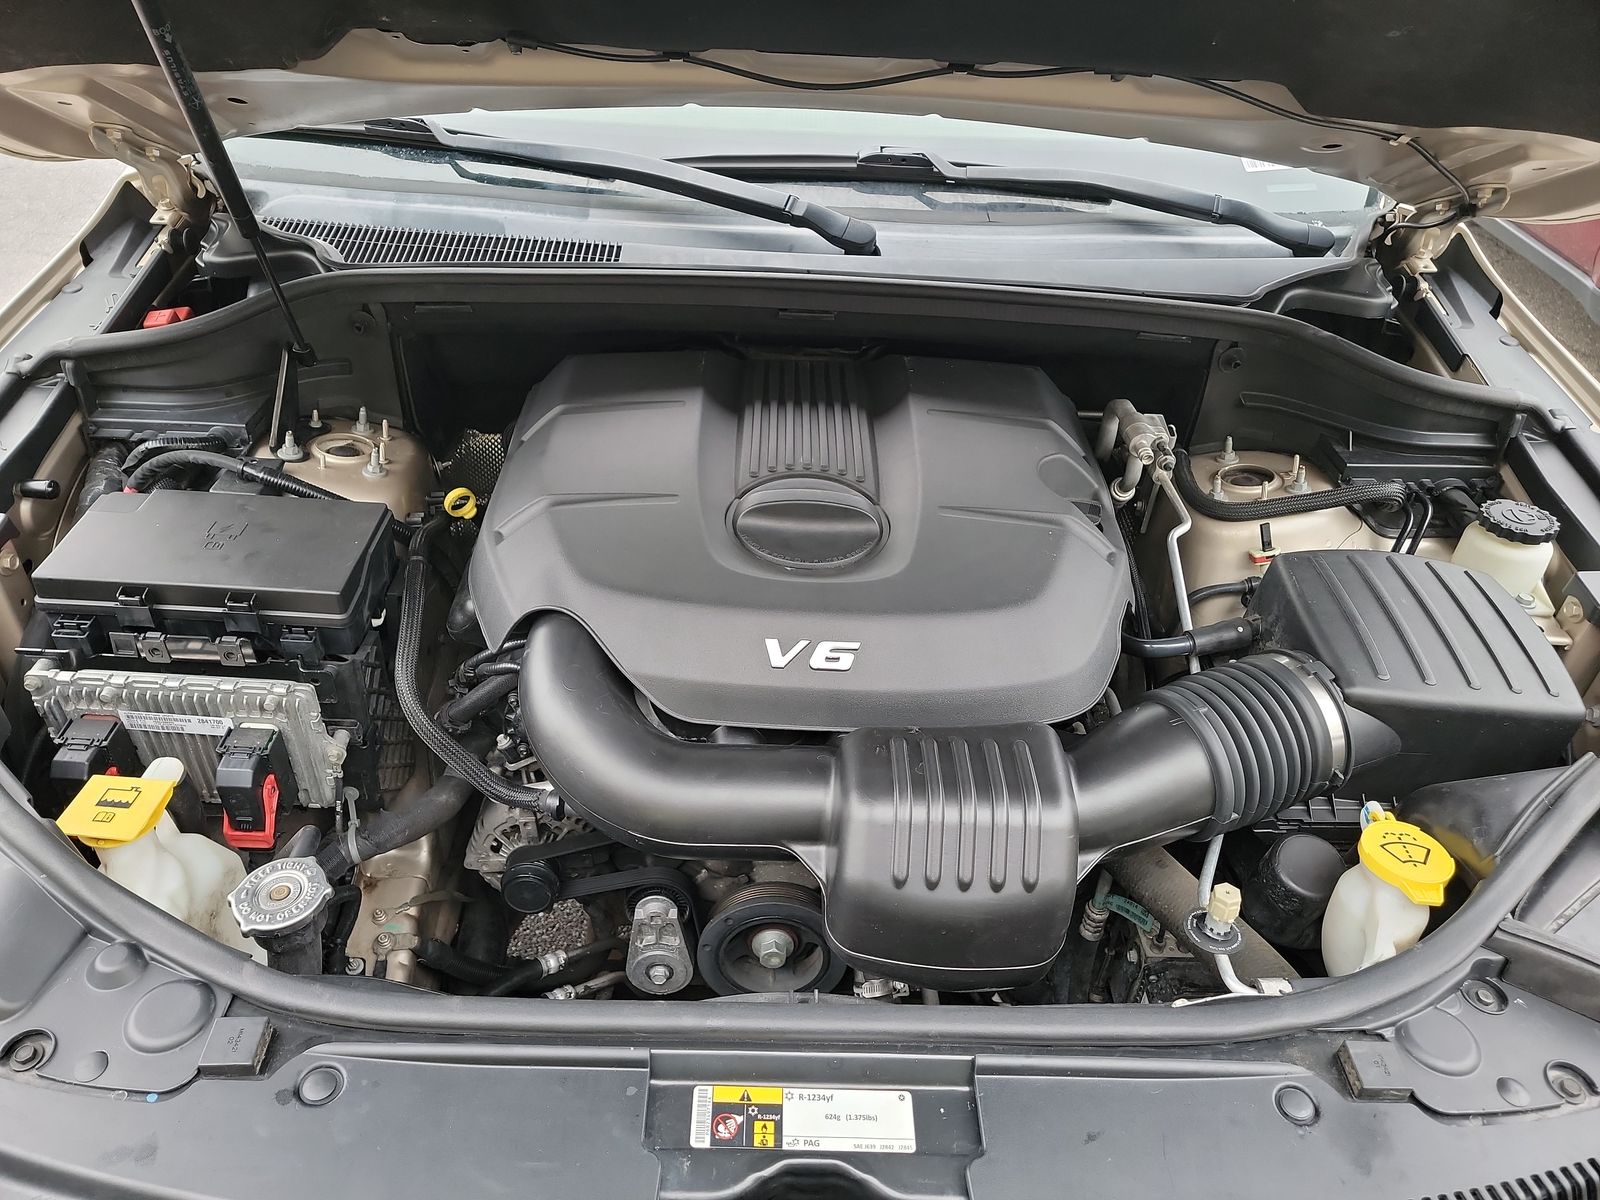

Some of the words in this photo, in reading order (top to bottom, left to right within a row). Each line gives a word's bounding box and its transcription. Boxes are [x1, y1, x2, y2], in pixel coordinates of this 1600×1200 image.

[161, 49, 190, 97] STABILUS
[764, 637, 861, 671] V6
[245, 866, 273, 888] KEEP
[276, 861, 306, 872] TIGHT
[239, 901, 252, 915] DO
[248, 912, 273, 922] NOT
[798, 1093, 834, 1103] R-1234yf
[757, 1113, 781, 1121] R-1234yf
[824, 1113, 841, 1122] 624g
[845, 1113, 878, 1122] (1.375lbs)
[803, 1139, 820, 1148] PAG
